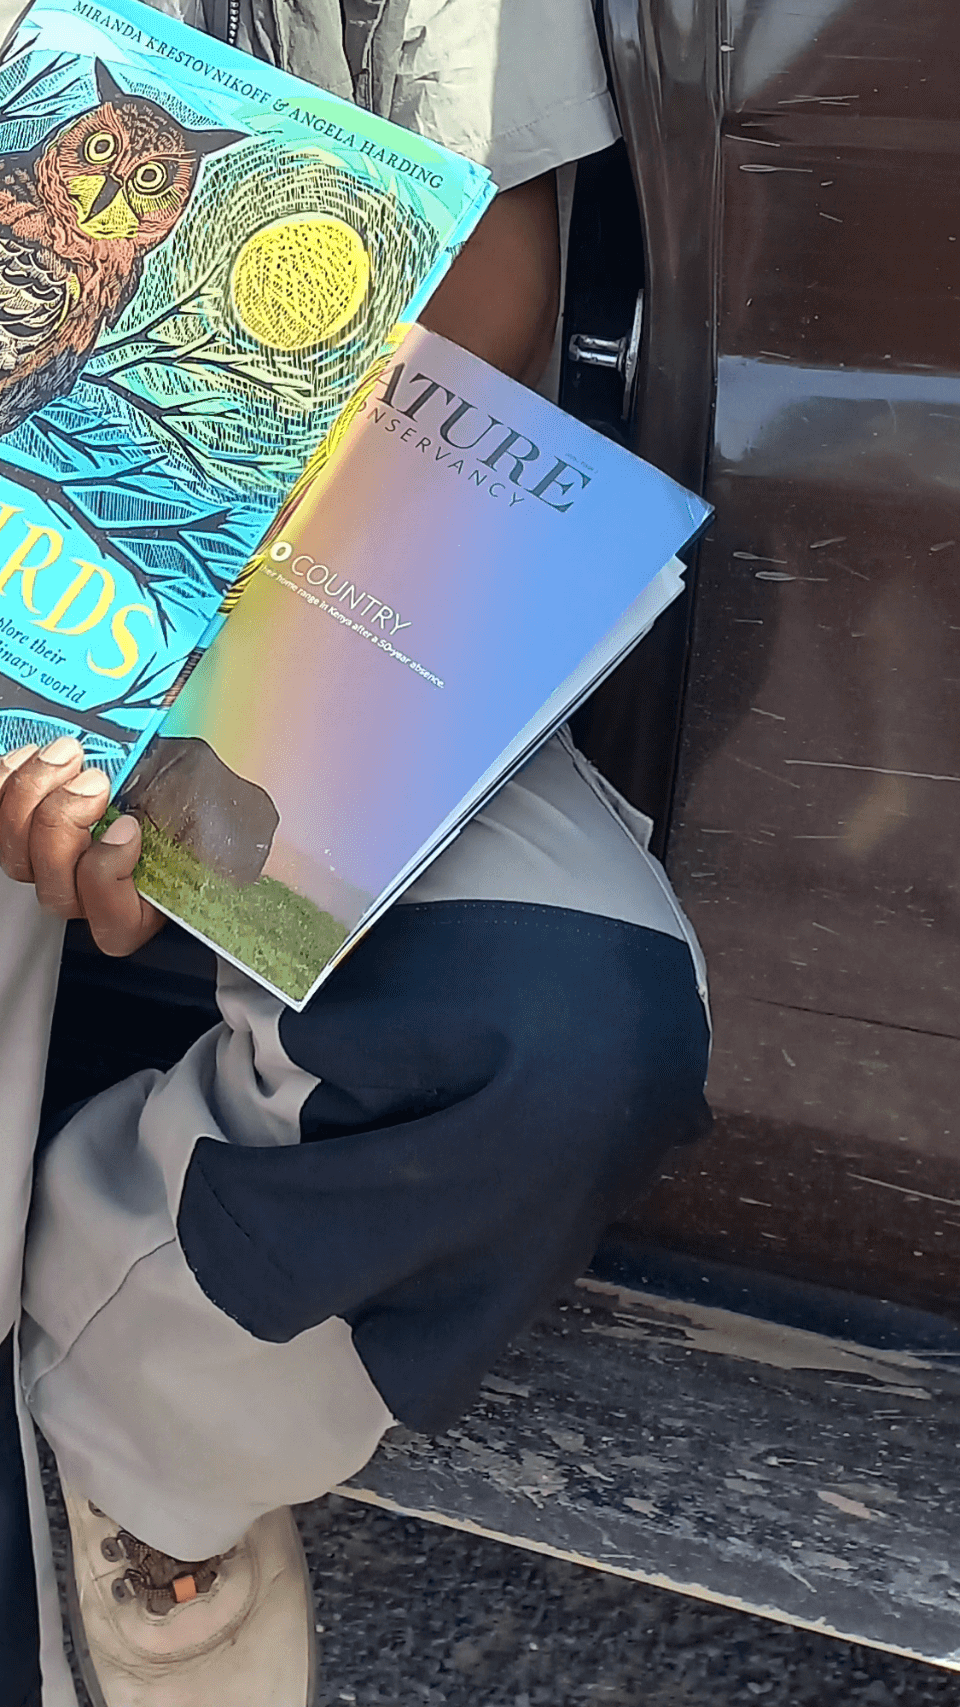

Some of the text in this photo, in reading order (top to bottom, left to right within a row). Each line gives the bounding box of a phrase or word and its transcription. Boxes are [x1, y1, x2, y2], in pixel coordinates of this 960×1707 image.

[72, 0, 444, 189] MIRANDA KRESTOVNIKOFF & ANGELA HARDING
[374, 361, 592, 513] ATURE
[276, 574, 298, 592] home
[297, 587, 320, 605] range
[327, 605, 352, 626] Kenya
[352, 622, 372, 639] after
[377, 639, 411, 664] 50-year
[291, 555, 412, 635] COUNTRY
[30, 639, 67, 666] their
[40, 672, 87, 704] world
